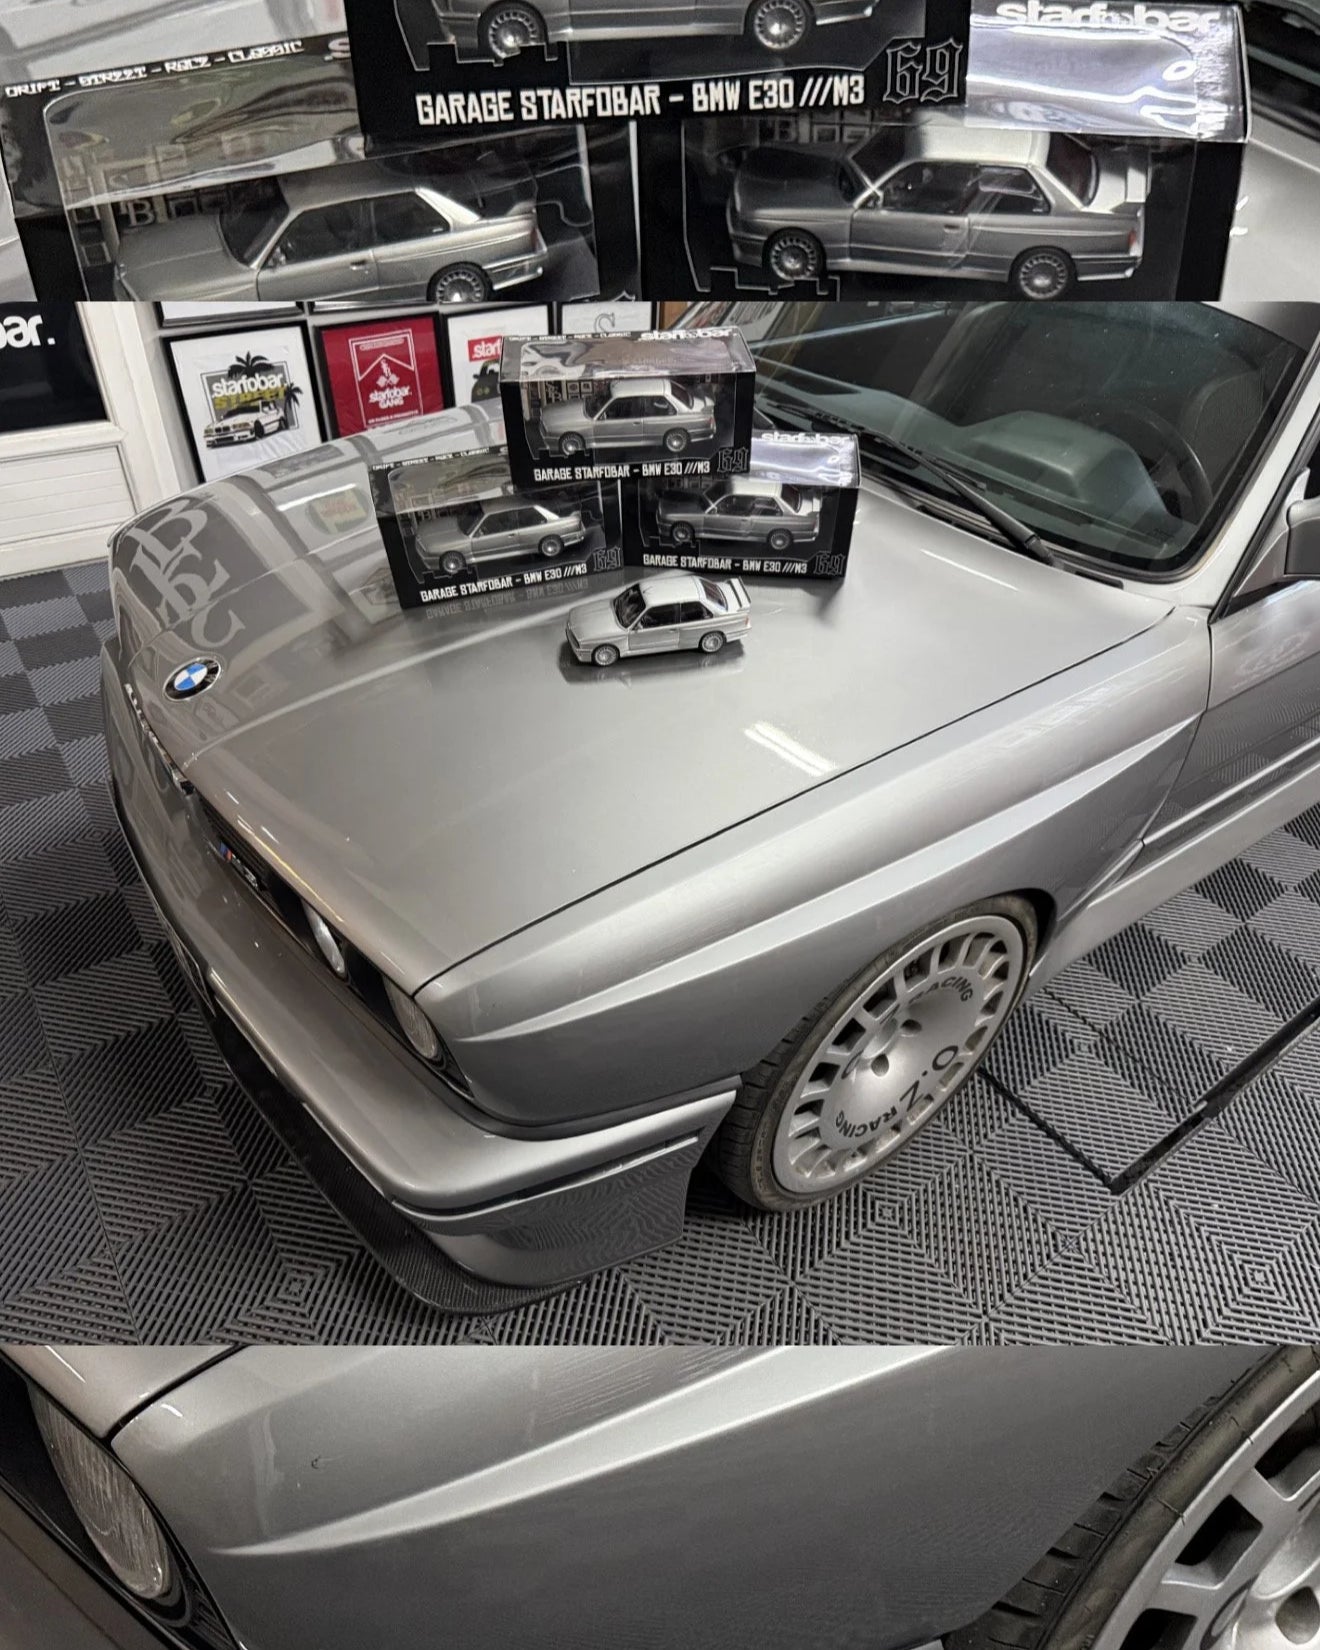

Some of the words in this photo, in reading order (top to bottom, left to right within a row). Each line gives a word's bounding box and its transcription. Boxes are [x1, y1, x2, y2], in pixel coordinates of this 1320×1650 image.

[883, 38, 963, 103] 69
[416, 92, 514, 126] GARAGE
[521, 83, 661, 120] STARFOBAR
[692, 83, 740, 112] BMW
[748, 79, 793, 110] E30
[800, 75, 865, 107] ///M3
[0, 314, 56, 350] ar.
[534, 468, 573, 481] GARAGE
[574, 465, 630, 480] STARFOBAR
[642, 463, 661, 477] BMW
[664, 462, 682, 476] E30
[643, 553, 679, 567] GARAGE
[680, 556, 732, 571] STARFOBAR
[742, 561, 762, 573] BMW
[763, 562, 782, 573] E30
[420, 586, 459, 603] GARAGE
[460, 575, 514, 596] STARFOBAR
[524, 571, 543, 585] BMW
[545, 567, 563, 581] E30
[909, 975, 974, 1003] ACING
[835, 1104, 898, 1139] RACING
